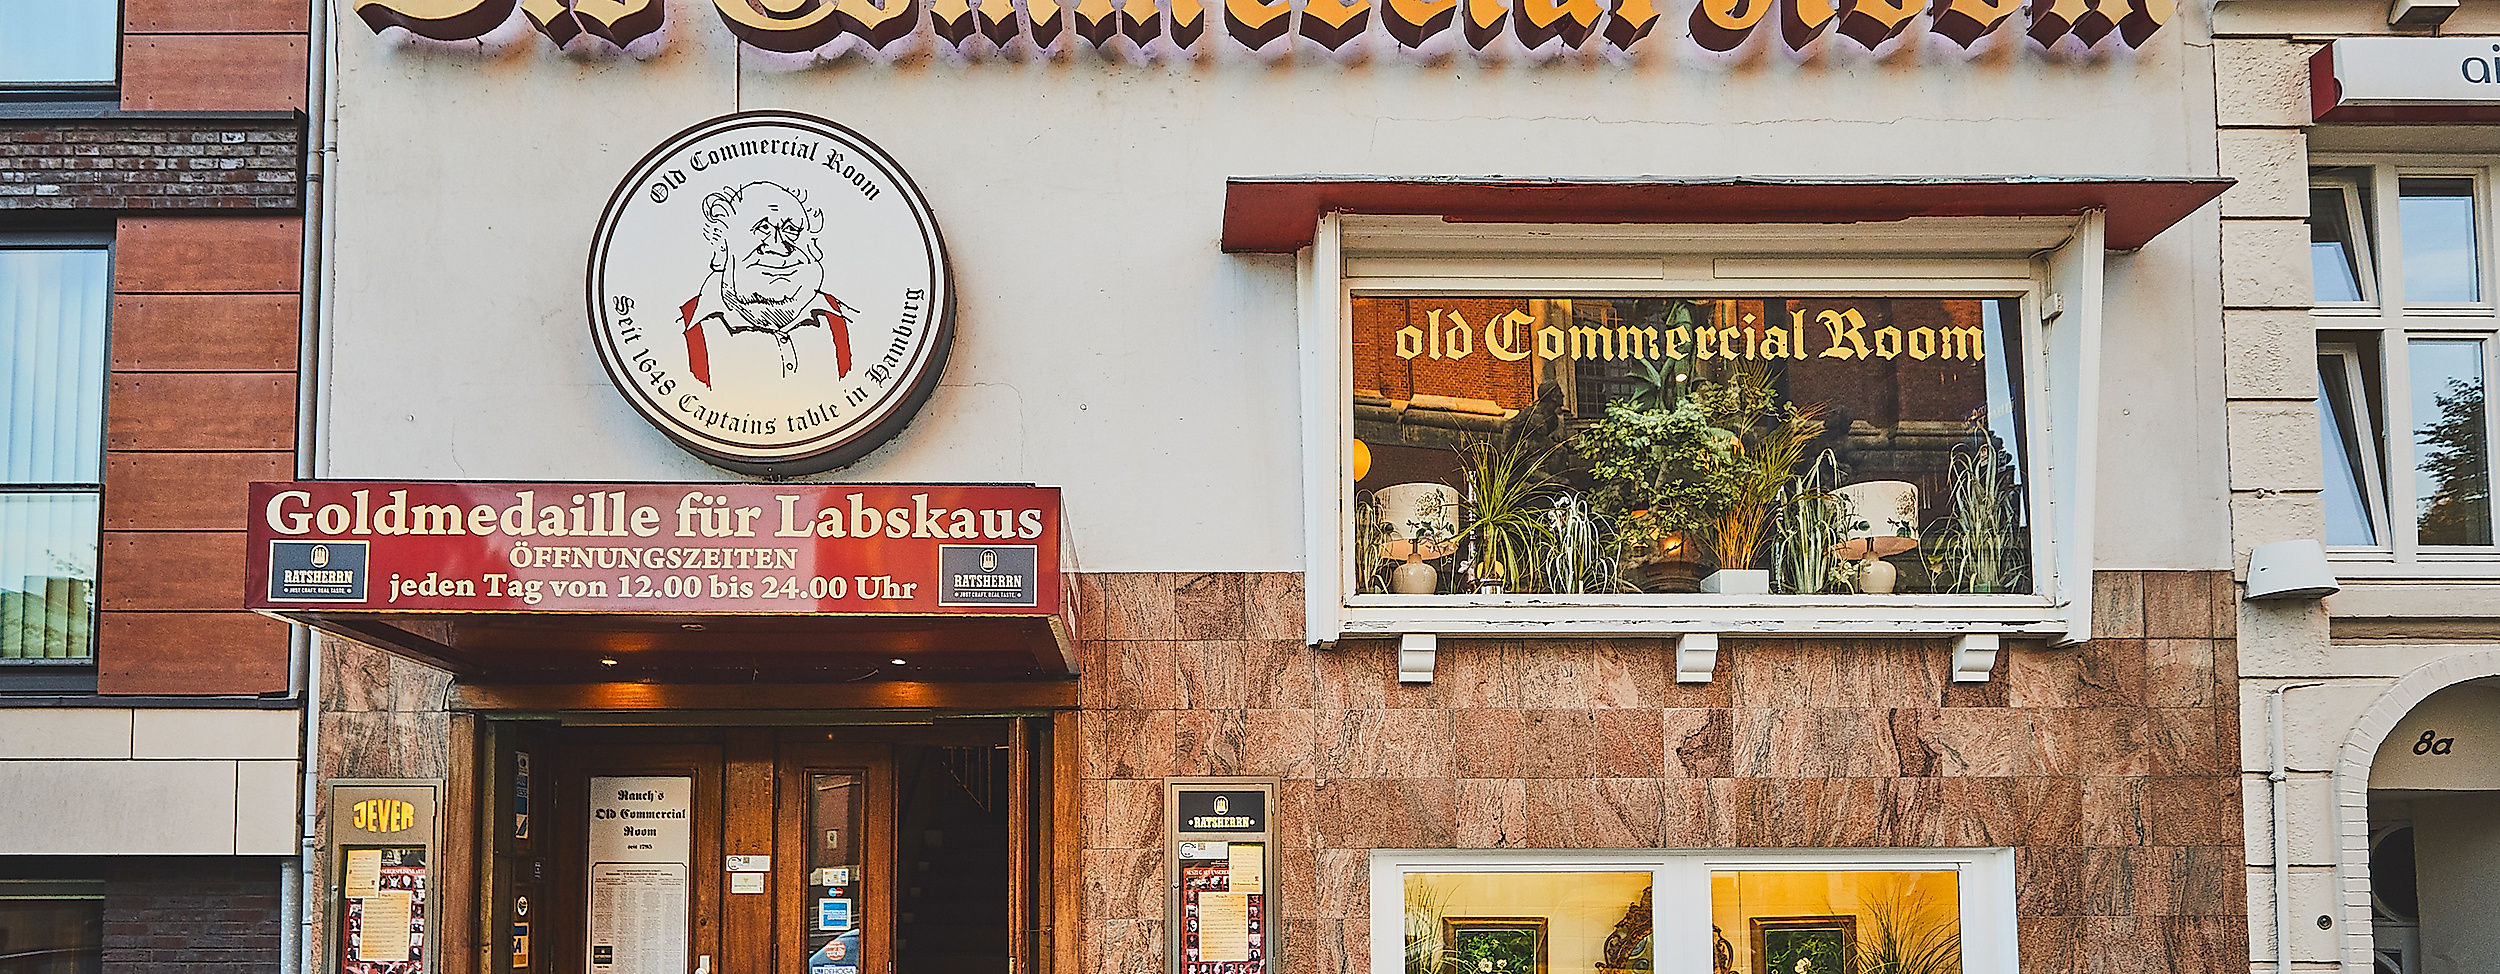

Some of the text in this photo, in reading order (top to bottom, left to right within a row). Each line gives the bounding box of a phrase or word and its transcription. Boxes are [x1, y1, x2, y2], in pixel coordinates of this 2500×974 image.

[649, 135, 881, 204] Old Commercial Room
[1395, 306, 1987, 363] old Commercial Room
[611, 287, 926, 437] Seit 1648 Captains table in Hamburg
[265, 489, 1044, 540] Goldmedaille für Labskaus
[508, 540, 799, 570] ÖFFNUNGSZEITEN
[283, 570, 354, 584] RATSHERRN
[388, 573, 918, 604] jeden Tag von 12.00 bis 24.00 Uhr
[953, 574, 1023, 588] RATSHERRN
[2412, 730, 2455, 755] 8a
[352, 798, 415, 833] JEVER
[595, 807, 687, 820] Old Commercial
[1193, 816, 1250, 829] RATSHERRN
[623, 825, 657, 838] Room
